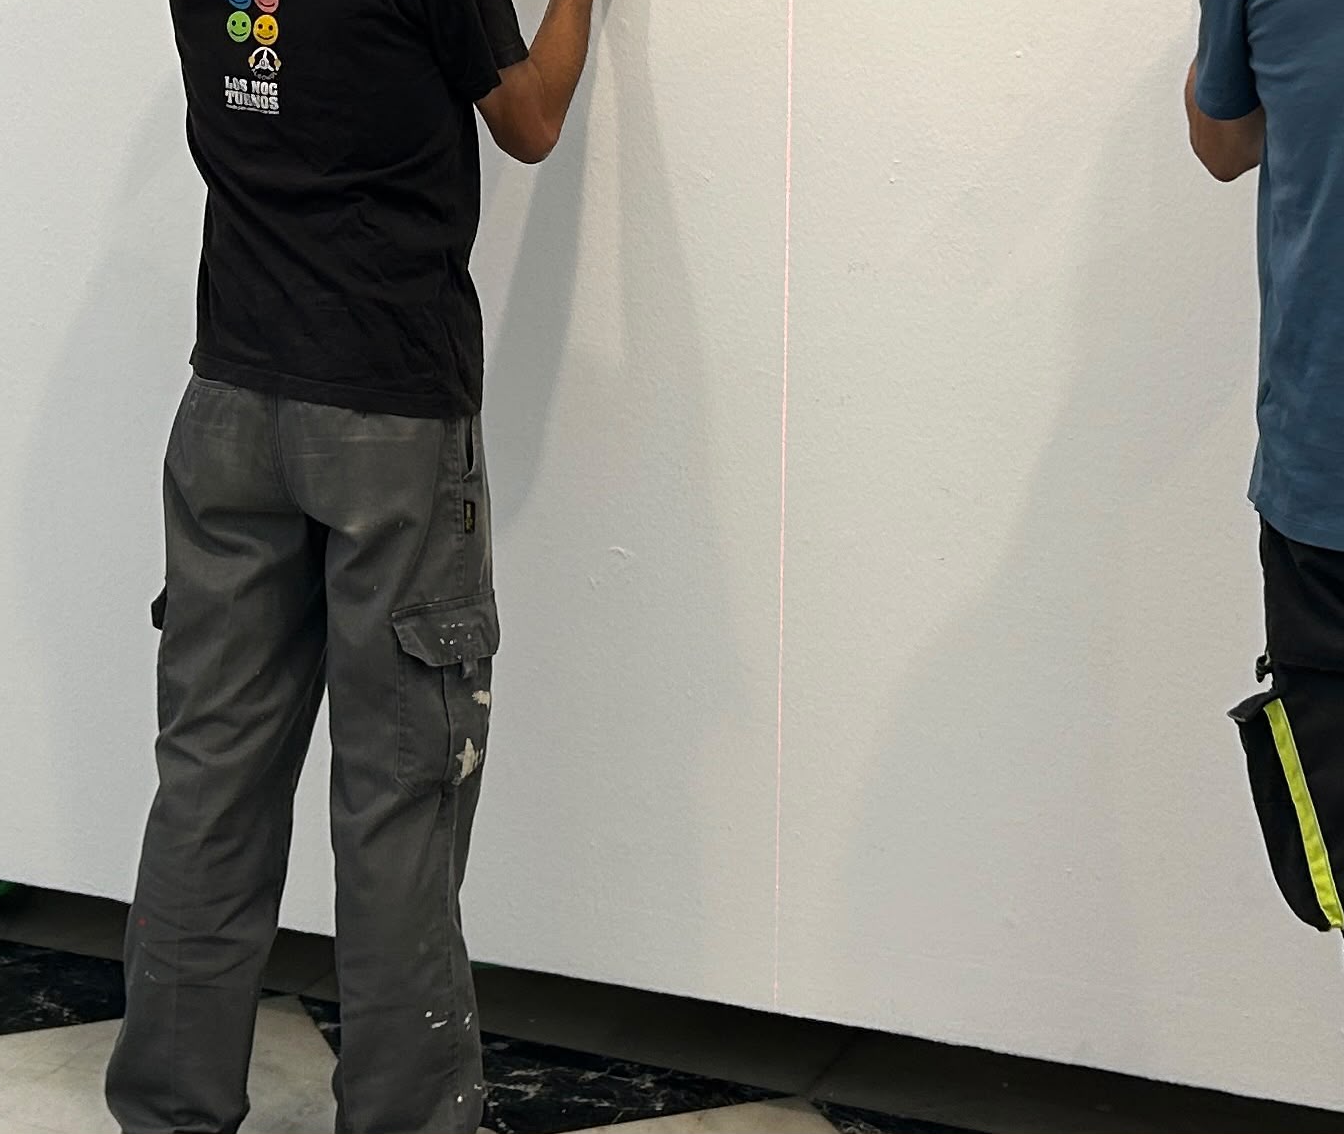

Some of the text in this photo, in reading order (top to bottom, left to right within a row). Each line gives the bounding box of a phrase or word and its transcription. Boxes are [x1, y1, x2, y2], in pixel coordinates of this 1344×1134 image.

[224, 75, 279, 97] LOS NOC
[224, 89, 280, 111] TURNOS
